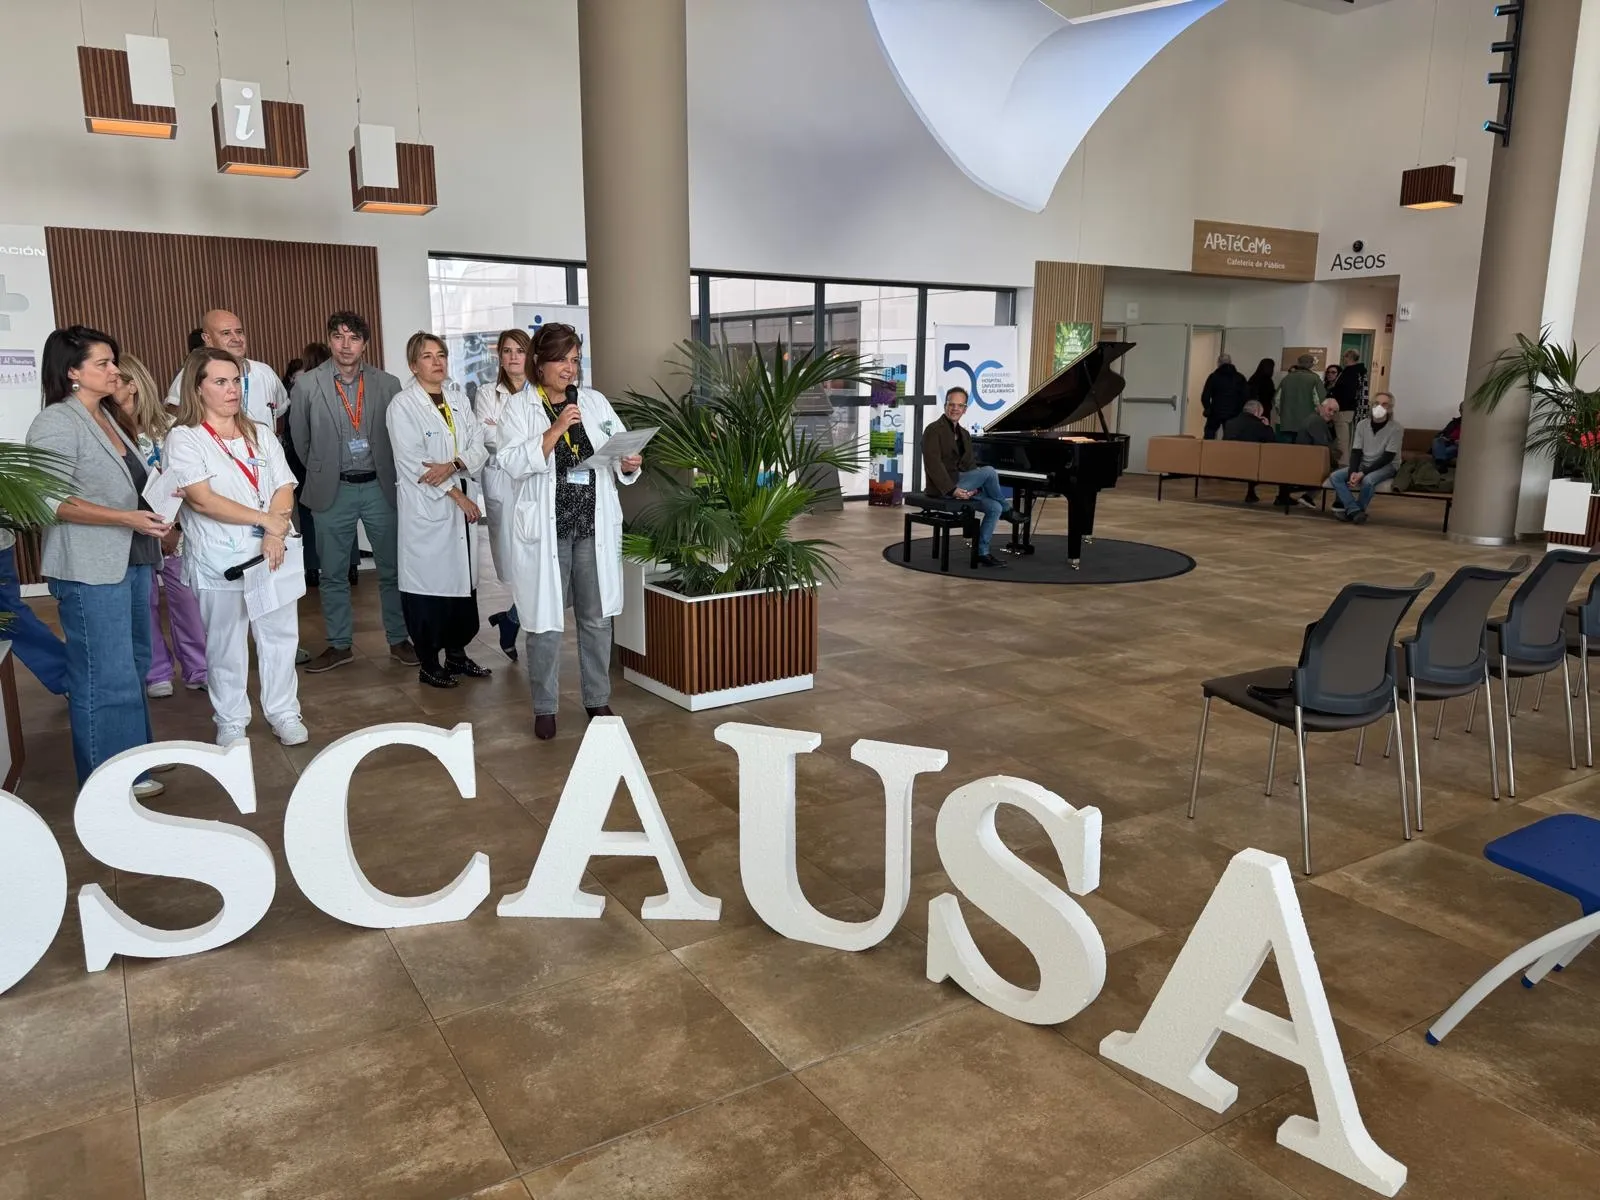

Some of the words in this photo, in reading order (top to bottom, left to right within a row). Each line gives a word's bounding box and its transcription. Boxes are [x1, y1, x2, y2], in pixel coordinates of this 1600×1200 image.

[1204, 232, 1272, 255] APeTéCeMe
[1264, 260, 1285, 270] Público
[1330, 254, 1387, 272] Aseos
